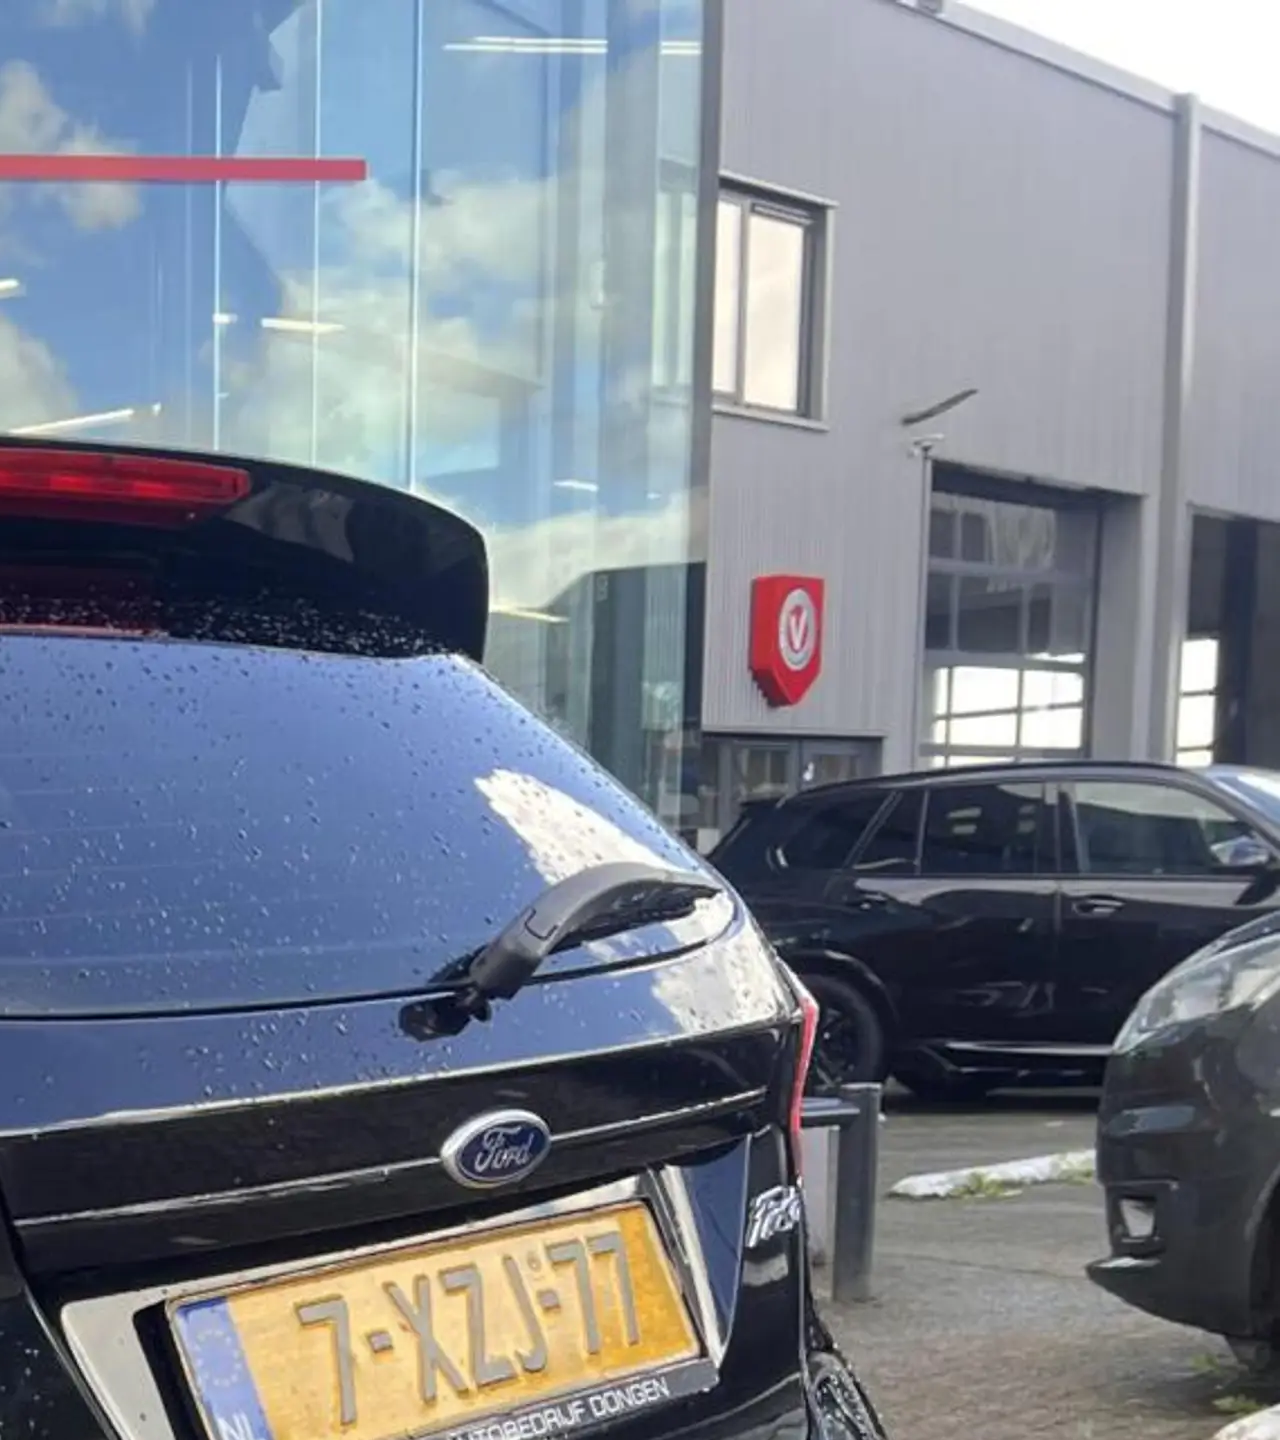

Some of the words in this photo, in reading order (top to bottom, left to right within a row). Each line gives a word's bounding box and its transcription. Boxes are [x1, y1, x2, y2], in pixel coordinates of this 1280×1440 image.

[474, 1126, 534, 1173] Ford
[295, 1229, 641, 1427] 7-XZJ-77
[589, 1376, 671, 1418] DONGEN
